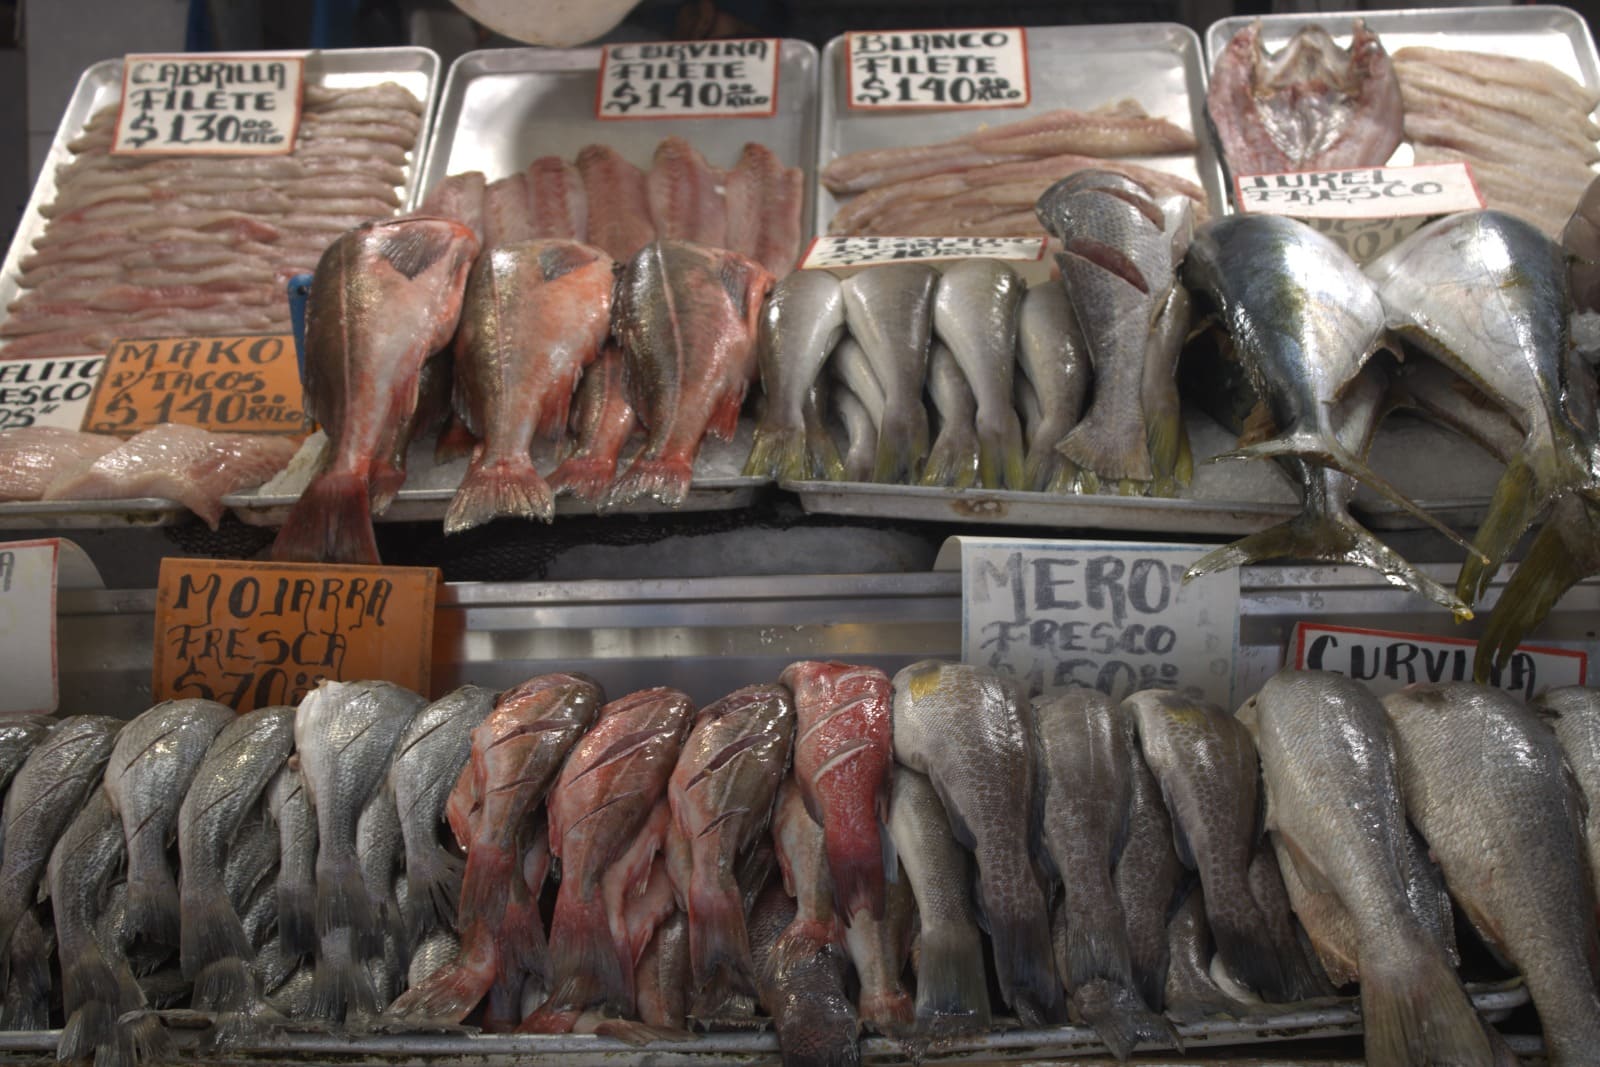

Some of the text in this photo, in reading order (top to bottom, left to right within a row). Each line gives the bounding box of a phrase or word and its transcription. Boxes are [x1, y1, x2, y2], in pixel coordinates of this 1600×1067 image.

[854, 32, 1008, 55] BLANCO
[131, 62, 286, 90] CABRILLA
[610, 61, 746, 80] FILETE
[855, 54, 998, 74] FILETE
[129, 88, 277, 111] FILETE
[1245, 181, 1444, 206] FRESCO
[119, 338, 284, 373] MAKO
[173, 573, 393, 631] MOJARRA
[973, 552, 1171, 628] MERO
[980, 618, 1177, 655] FRESCO
[167, 624, 347, 683] FRESCA
